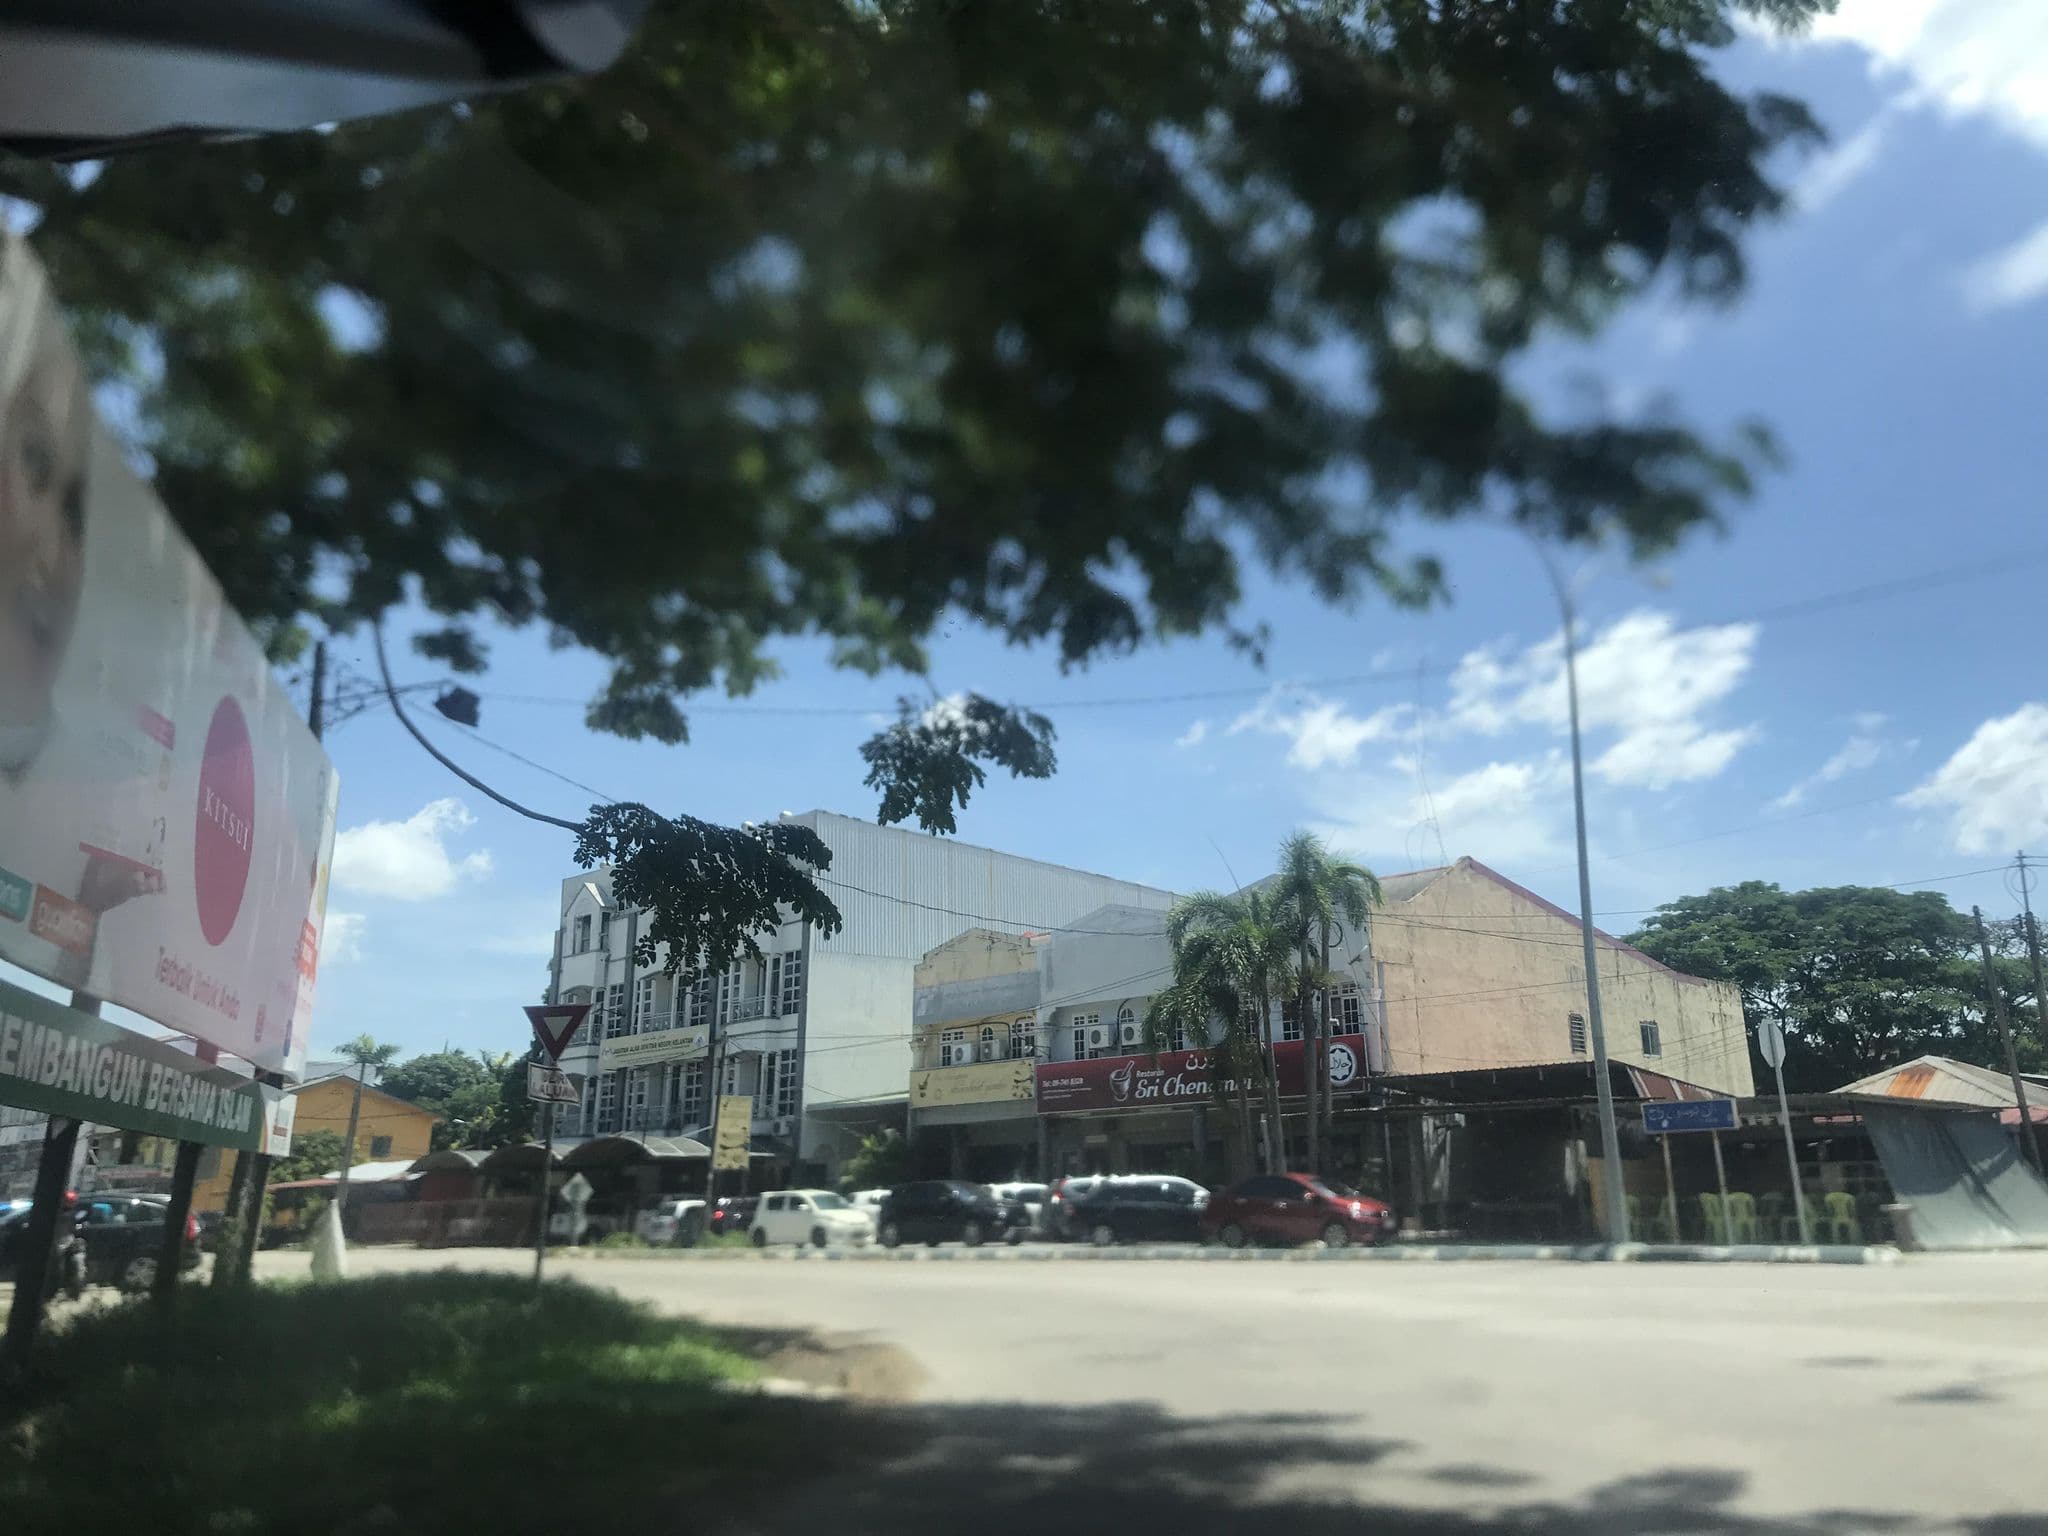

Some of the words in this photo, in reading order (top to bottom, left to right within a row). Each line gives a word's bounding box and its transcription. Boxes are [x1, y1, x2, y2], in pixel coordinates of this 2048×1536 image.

[205, 786, 249, 852] KITSUI
[0, 1011, 146, 1108] EMBANGUN
[147, 1063, 217, 1126] BERSAMA
[216, 1088, 253, 1133] ISLAM
[1135, 1078, 1160, 1099] Sri
[1136, 1070, 1165, 1078] Restoran
